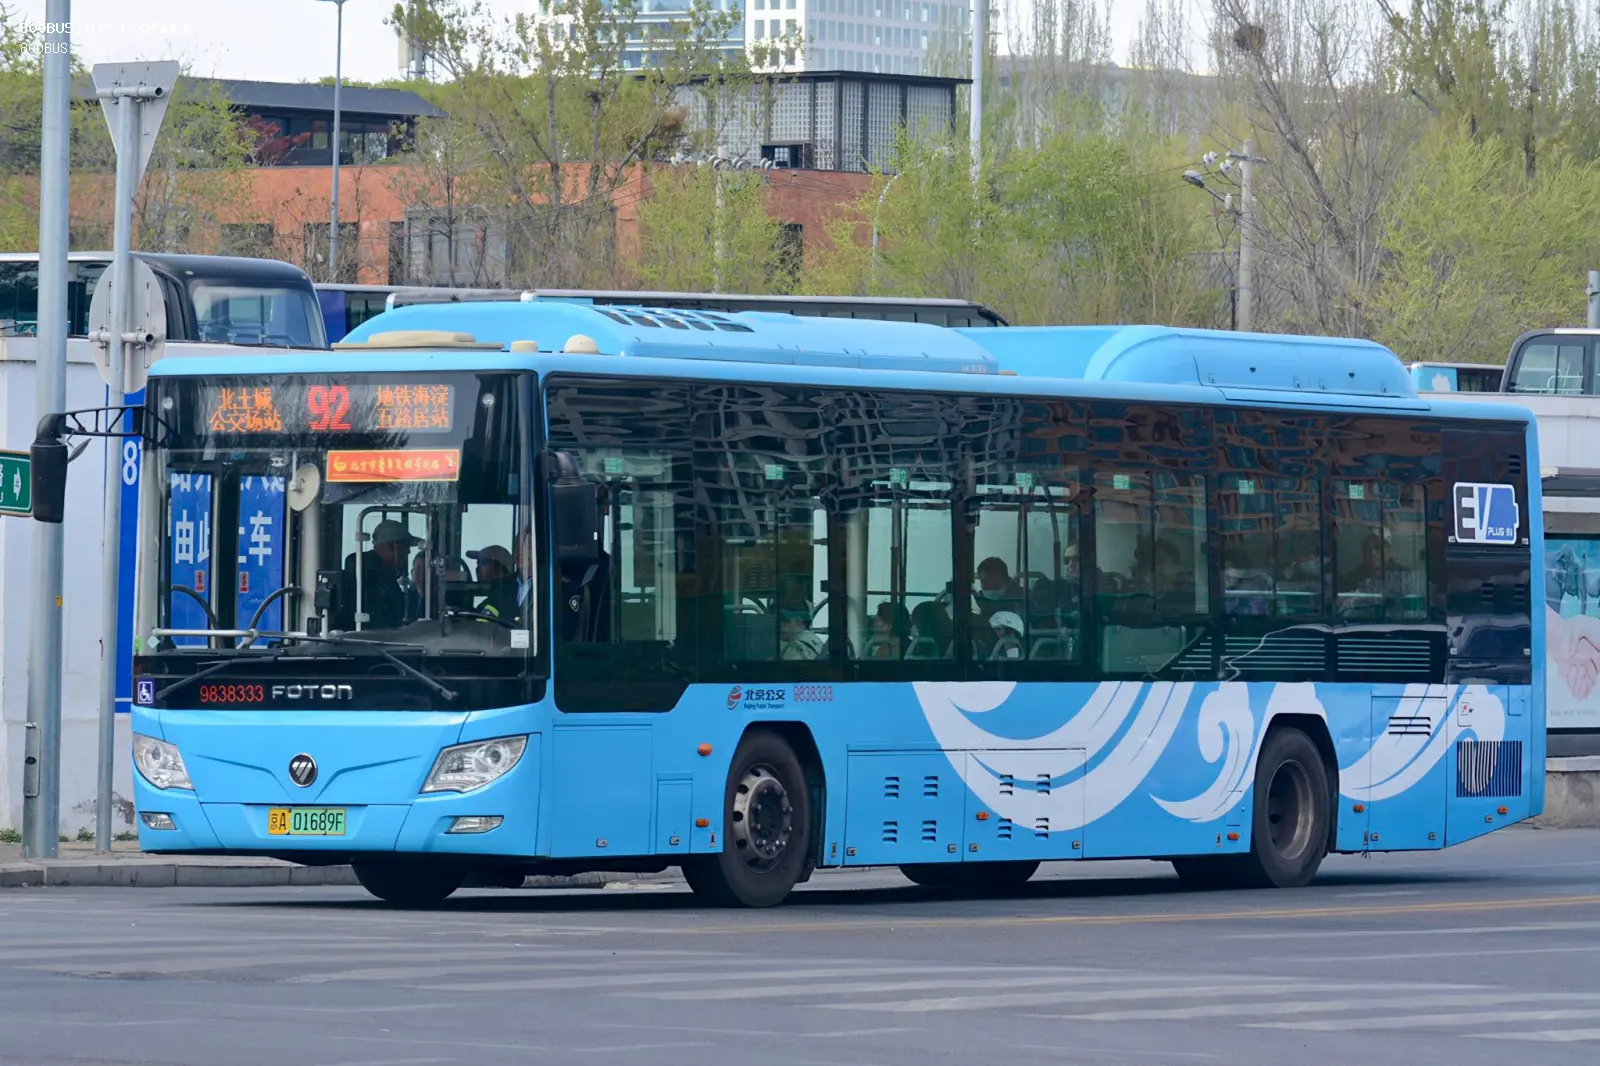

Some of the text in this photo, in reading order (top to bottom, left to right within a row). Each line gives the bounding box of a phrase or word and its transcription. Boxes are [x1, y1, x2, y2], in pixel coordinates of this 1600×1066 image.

[218, 387, 273, 410] 北土城
[376, 385, 449, 406] 地铁海淀
[307, 385, 351, 430] 92
[376, 407, 449, 428] 五路居站
[209, 408, 283, 432] 公交场站
[200, 684, 353, 702] 9838333 FOTON
[744, 689, 785, 701] 北京公交
